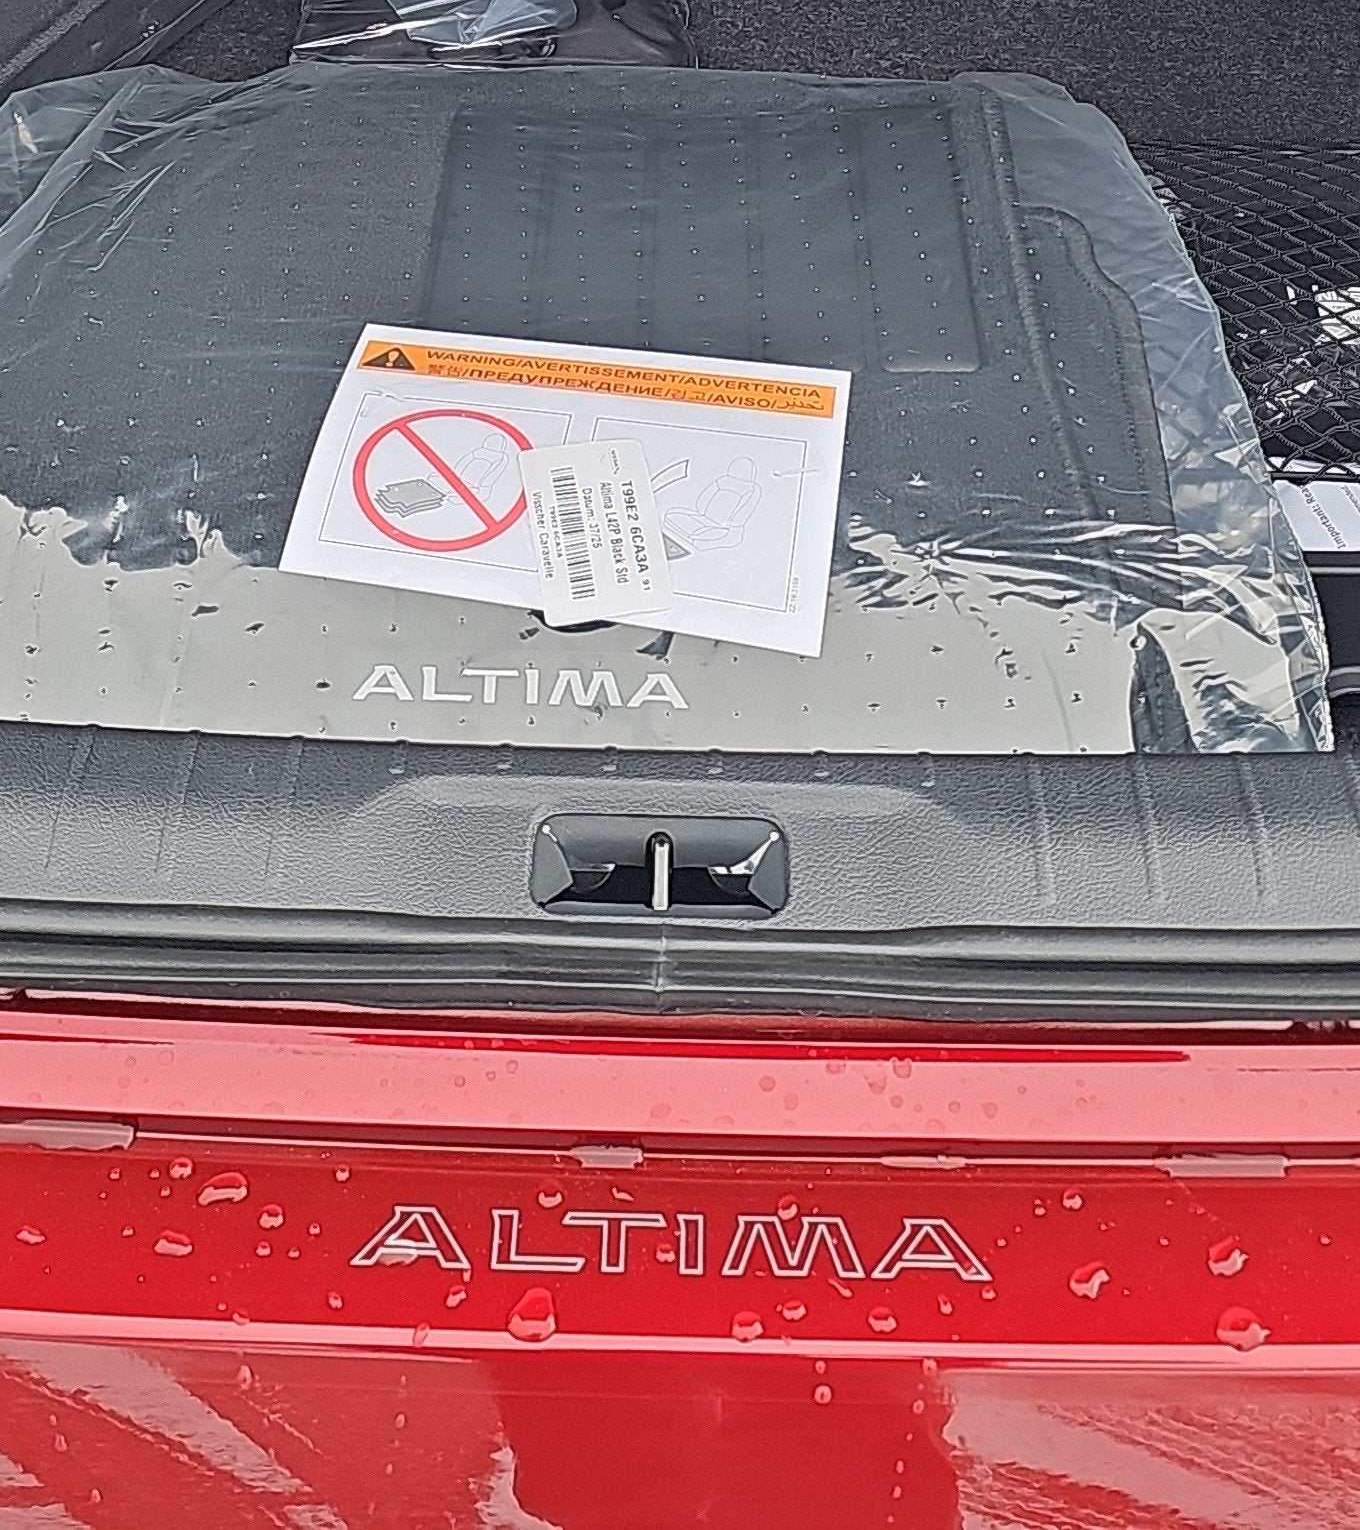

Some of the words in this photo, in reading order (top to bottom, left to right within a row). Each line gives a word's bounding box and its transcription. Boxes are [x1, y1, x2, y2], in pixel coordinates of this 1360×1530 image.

[427, 350, 821, 398] WARNING/AVERTISSEMENT/ADVERTENCIA
[600, 482, 613, 509] Altima
[621, 480, 639, 521] T99E2
[532, 491, 545, 529] Visscher
[539, 533, 554, 579] Caravelle
[582, 488, 595, 520] Datum:
[589, 523, 602, 549] 37/25
[605, 512, 621, 535] L42P
[1312, 504, 1346, 549] Important:
[610, 538, 626, 564] Black
[629, 527, 649, 573] 6CA3A
[616, 566, 630, 584] Std
[642, 579, 651, 591] 91
[352, 664, 690, 710] ALTIMA
[349, 1205, 994, 1282] ALTIMA
